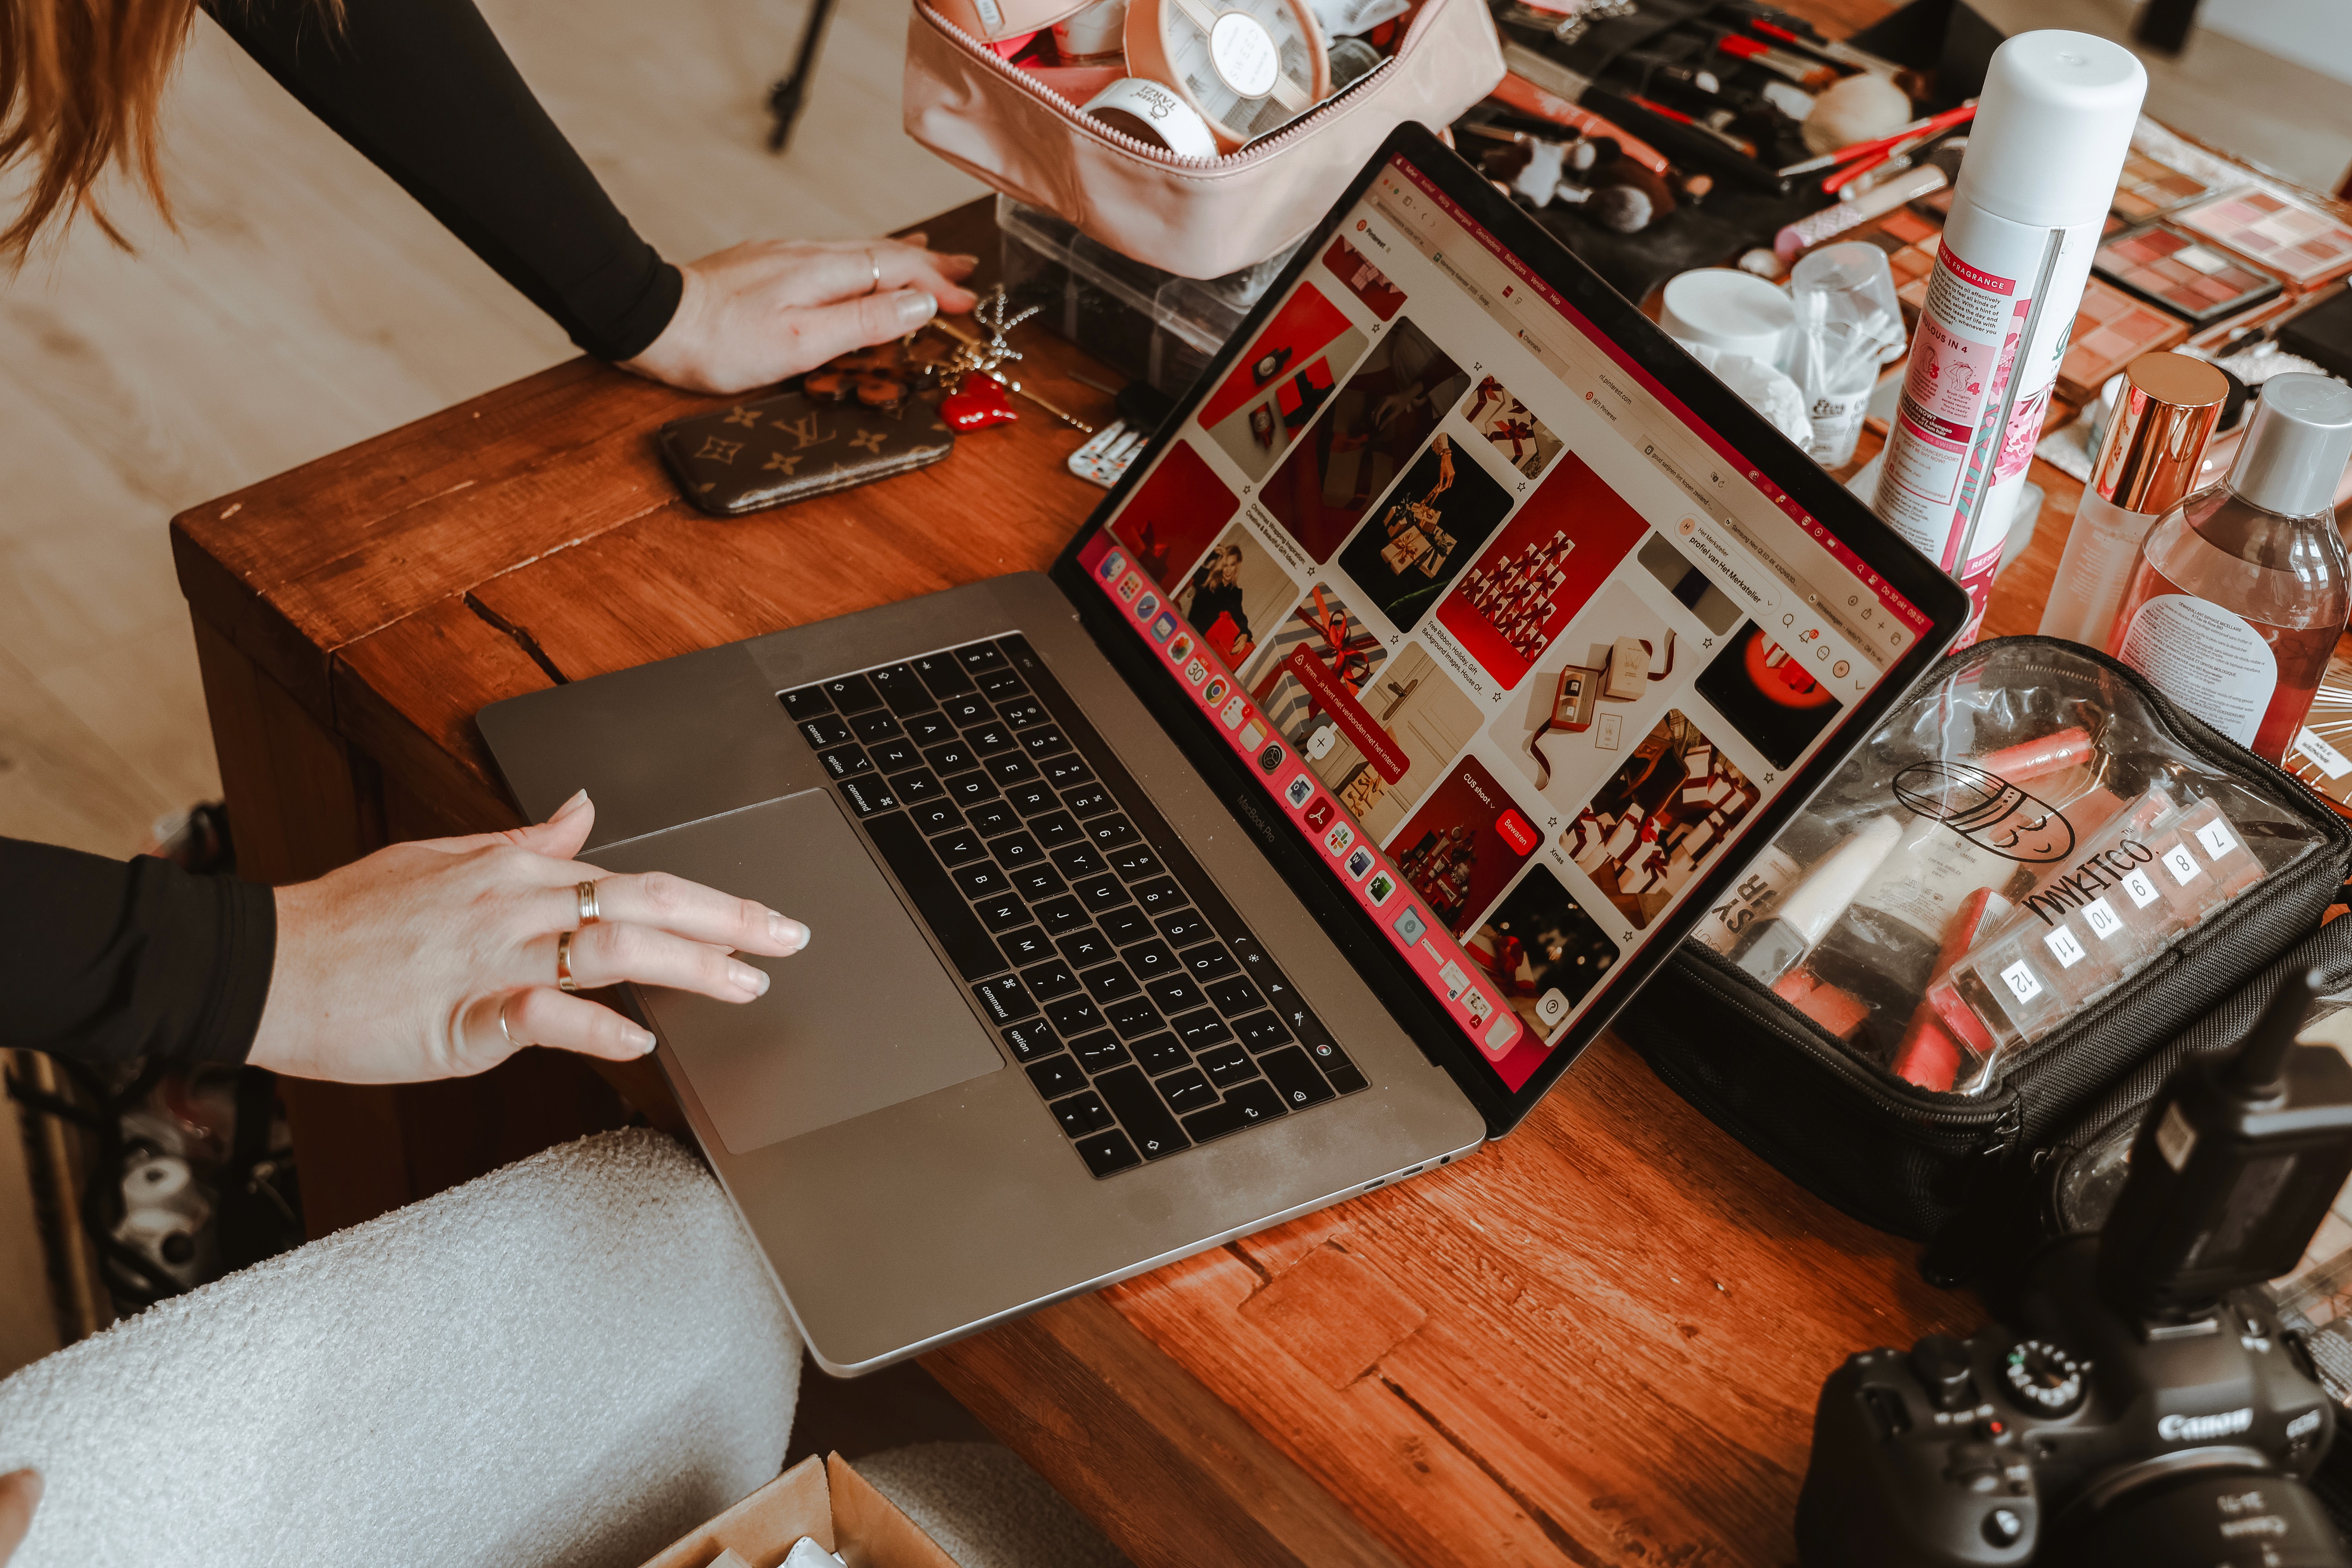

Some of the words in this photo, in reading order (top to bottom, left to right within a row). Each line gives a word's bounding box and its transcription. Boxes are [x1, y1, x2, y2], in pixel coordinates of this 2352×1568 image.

[1365, 227, 1387, 249] Pinterest
[1475, 227, 1503, 253] Geschiedenis
[1503, 253, 1528, 276] Bladwijzers
[1529, 276, 1547, 292] Venster
[1548, 294, 1561, 306] Help
[1953, 261, 2005, 290] FRAGRANCE
[1946, 275, 1964, 290] removes
[1971, 290, 2001, 305] effectively
[1957, 289, 1966, 298] feel
[1974, 298, 1989, 307] kinds
[1944, 303, 1953, 312] new
[1953, 308, 1965, 318] lease
[1952, 294, 1960, 303] out.
[1962, 299, 1974, 309] With
[1953, 302, 1964, 311] seize
[1922, 314, 1946, 343] BULOUS
[1948, 338, 1958, 350] IN
[1958, 319, 1985, 332] whenever
[1522, 334, 1543, 354] Channable
[1929, 364, 1940, 379] 3
[1597, 373, 1633, 405] nl.pinterest.com
[1967, 382, 1980, 396] 4
[1591, 397, 1602, 408] (67)
[1599, 405, 1618, 422] Pinterest
[1811, 397, 1844, 414] Etos
[1915, 404, 1937, 421] KNOW?
[1929, 420, 1953, 434] shampoo
[1651, 452, 1664, 465] goud
[1660, 461, 1678, 477] satijnen
[1675, 473, 1684, 482] lint
[1681, 479, 1695, 493] kopen
[1692, 489, 1710, 505] zeeland
[1245, 509, 1262, 528] Creative
[1262, 528, 1281, 549] Beautiful
[1277, 544, 1288, 557] Gift
[1250, 502, 1271, 526] Christmas
[1267, 521, 1288, 545] Wrapping
[1696, 526, 1708, 539] Het
[1704, 535, 1730, 559] Merkatelier
[1729, 524, 1751, 544] Samsung
[1748, 539, 1759, 551] Neo
[1756, 547, 1771, 561] QLED
[1768, 557, 1777, 566] 4K
[1687, 535, 1711, 558] profiel
[1706, 553, 1720, 566] van
[1717, 561, 1731, 575] Het
[1726, 570, 1763, 605] Merkatelier
[1888, 592, 1899, 603] 30
[1895, 599, 1907, 611] okt
[1420, 627, 1447, 657] Background
[1443, 652, 1463, 674] Images,
[1459, 668, 1476, 687] House
[1426, 620, 1439, 633] Free
[1435, 629, 1454, 651] Ribbon,
[1450, 645, 1470, 668] Holiday,
[1466, 662, 1479, 676] Gift
[1187, 661, 1205, 683] 30
[808, 725, 826, 743] control
[1317, 679, 1326, 690] je
[1323, 684, 1336, 701] bent
[1332, 695, 1345, 710] niet
[1341, 705, 1368, 736] verbonden
[1364, 732, 1376, 747] met
[1373, 742, 1384, 755] het
[1380, 751, 1401, 775] internet
[828, 756, 843, 773] option
[848, 784, 871, 811] command
[1462, 772, 1477, 789] CUS
[1473, 784, 1491, 805] shoot
[1236, 793, 1267, 831] MacBook
[1261, 826, 1277, 843] Pro
[1503, 818, 1529, 846] Bewaren
[2211, 831, 2225, 848] 7
[1549, 848, 1565, 866] Xmas
[2175, 855, 2190, 871] 8
[2132, 879, 2146, 897] 9
[2092, 908, 2112, 929] 10
[2055, 936, 2075, 958] 11
[2011, 971, 2034, 993] 12
[982, 986, 1008, 1017] command
[1012, 1031, 1029, 1051] option
[2157, 1408, 2254, 1442] Canon
